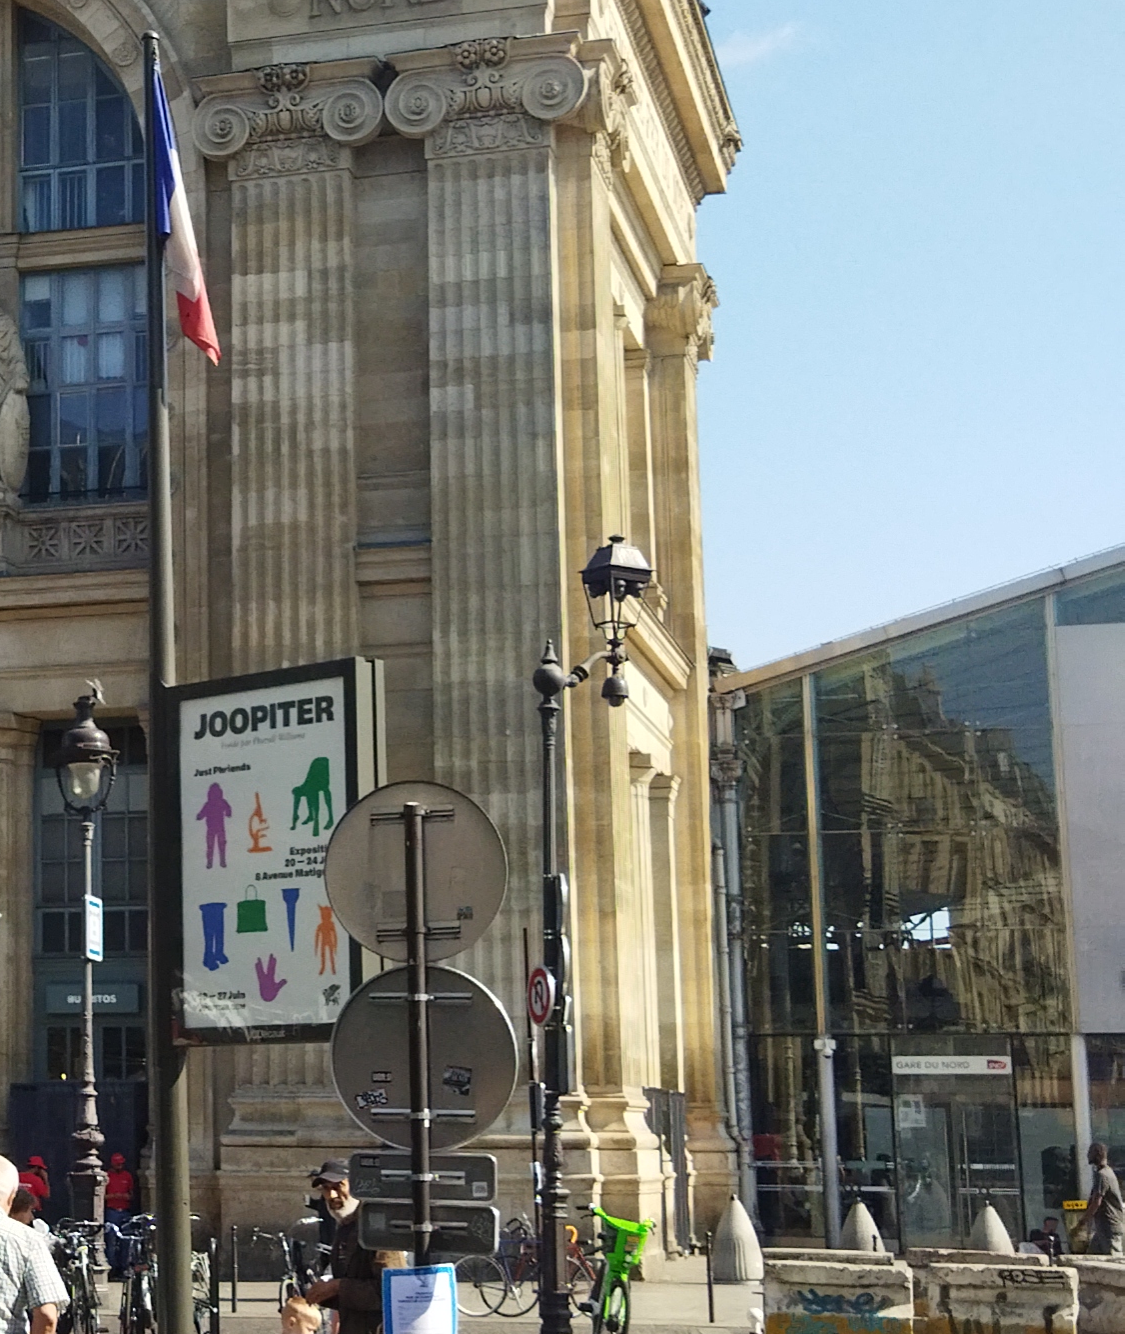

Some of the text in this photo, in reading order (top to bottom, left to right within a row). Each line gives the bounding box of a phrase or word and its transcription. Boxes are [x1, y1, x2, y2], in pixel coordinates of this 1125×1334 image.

[193, 695, 335, 741] JOOPITER
[194, 763, 251, 777] Just Phriends
[290, 844, 328, 856] Expositi
[285, 858, 296, 867] 20
[306, 856, 318, 865] 24
[262, 871, 293, 880] Avenue
[295, 867, 325, 878] Matig
[217, 992, 227, 1000] 27
[228, 990, 246, 999] Juin
[896, 1061, 922, 1069] GARE
[924, 1061, 939, 1069] DU
[941, 1060, 970, 1069] NORD
